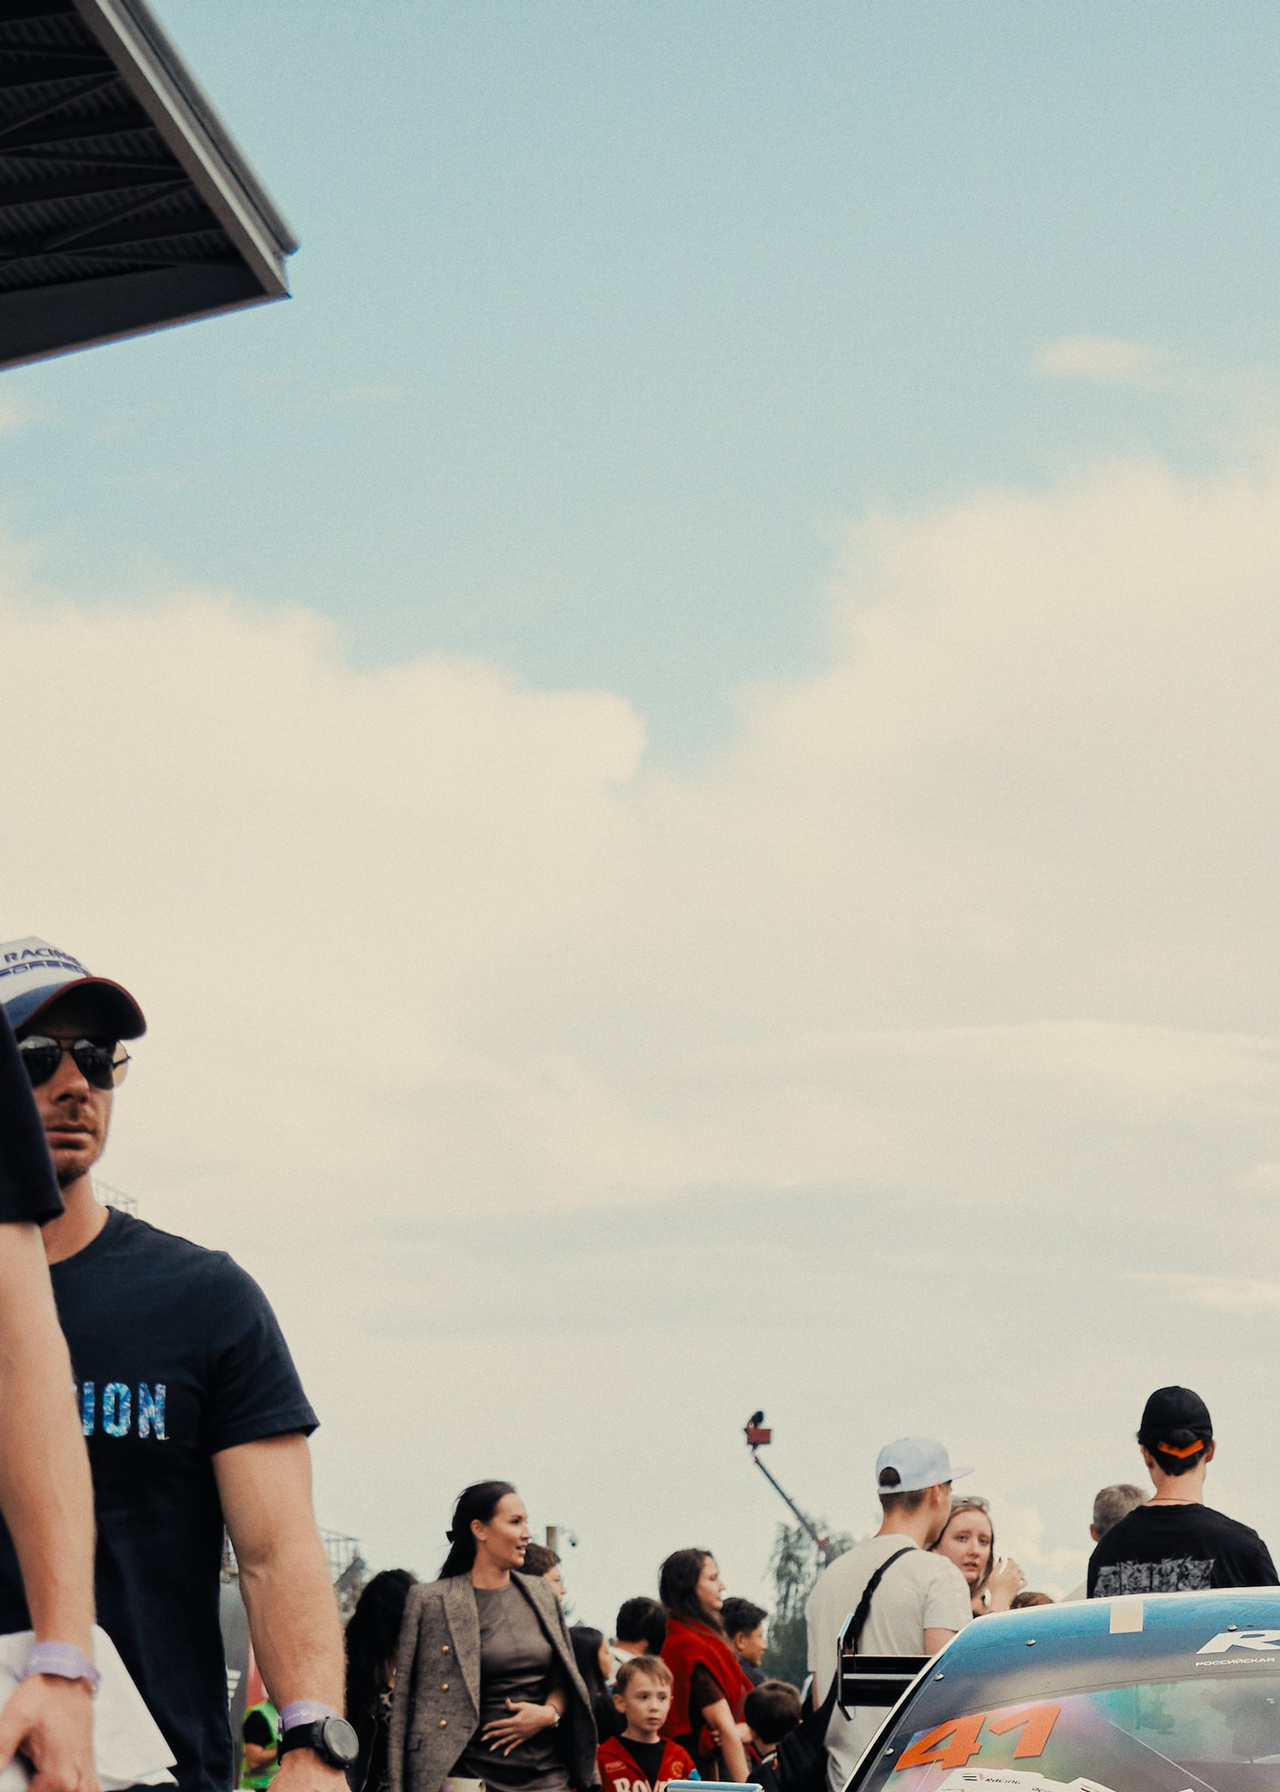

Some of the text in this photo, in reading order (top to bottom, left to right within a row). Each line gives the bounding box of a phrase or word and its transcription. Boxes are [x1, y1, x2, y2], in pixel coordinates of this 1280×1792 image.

[73, 1381, 168, 1440] ION
[1195, 1657, 1275, 1667] РОССИЙСКАЯ
[896, 1705, 1062, 1772] 41
